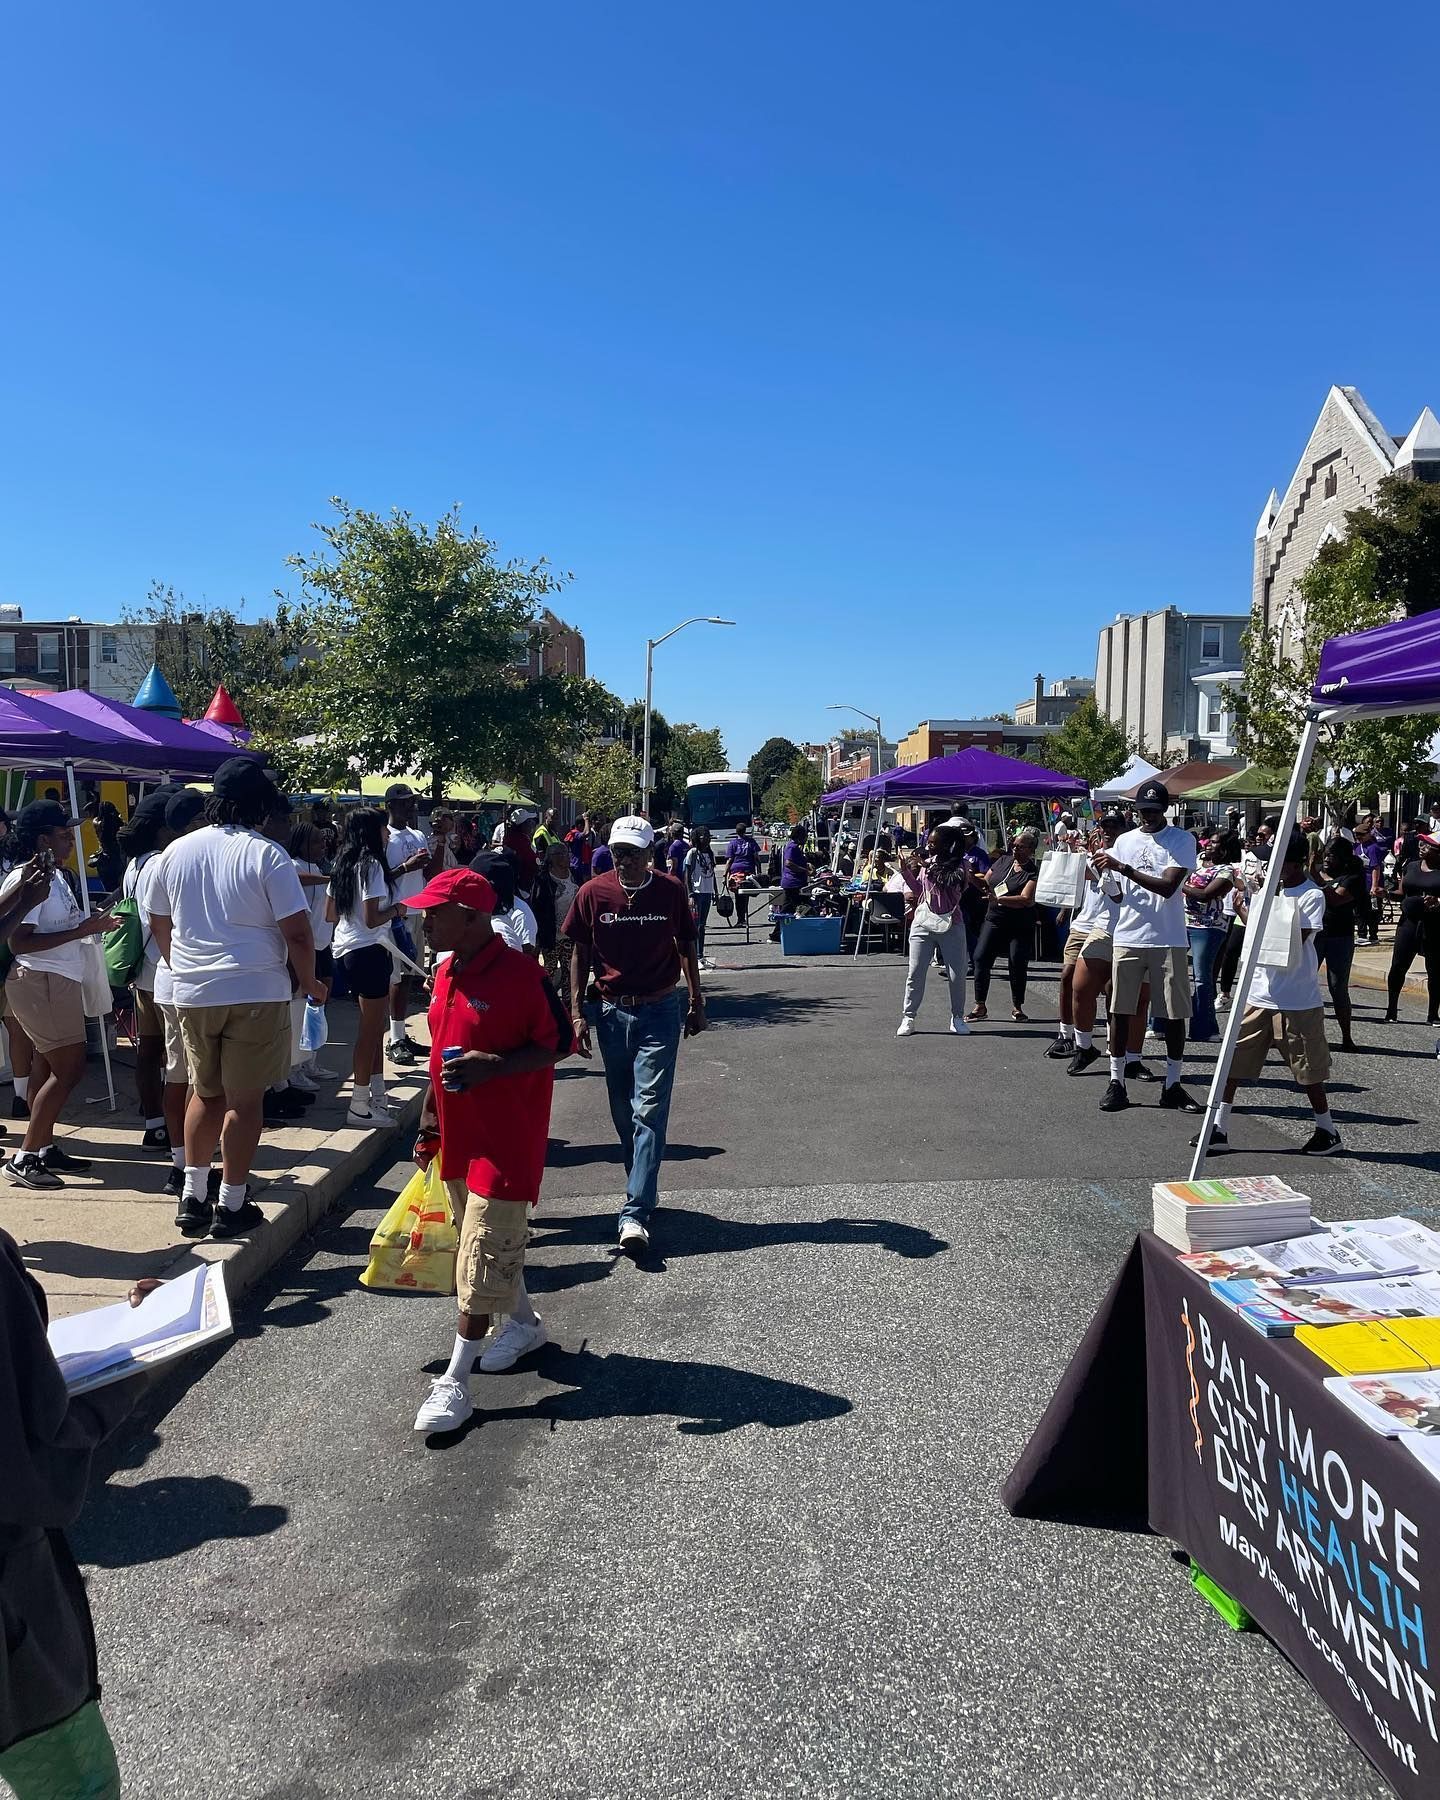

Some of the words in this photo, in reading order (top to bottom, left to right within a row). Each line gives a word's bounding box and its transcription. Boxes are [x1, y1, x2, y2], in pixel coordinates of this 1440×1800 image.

[599, 912, 668, 925] Champion
[1199, 1313, 1420, 1591] BALTIMORE
[1208, 1380, 1267, 1484] CITY
[1279, 1459, 1428, 1670] HEALTH
[1219, 1515, 1300, 1618] Maryland
